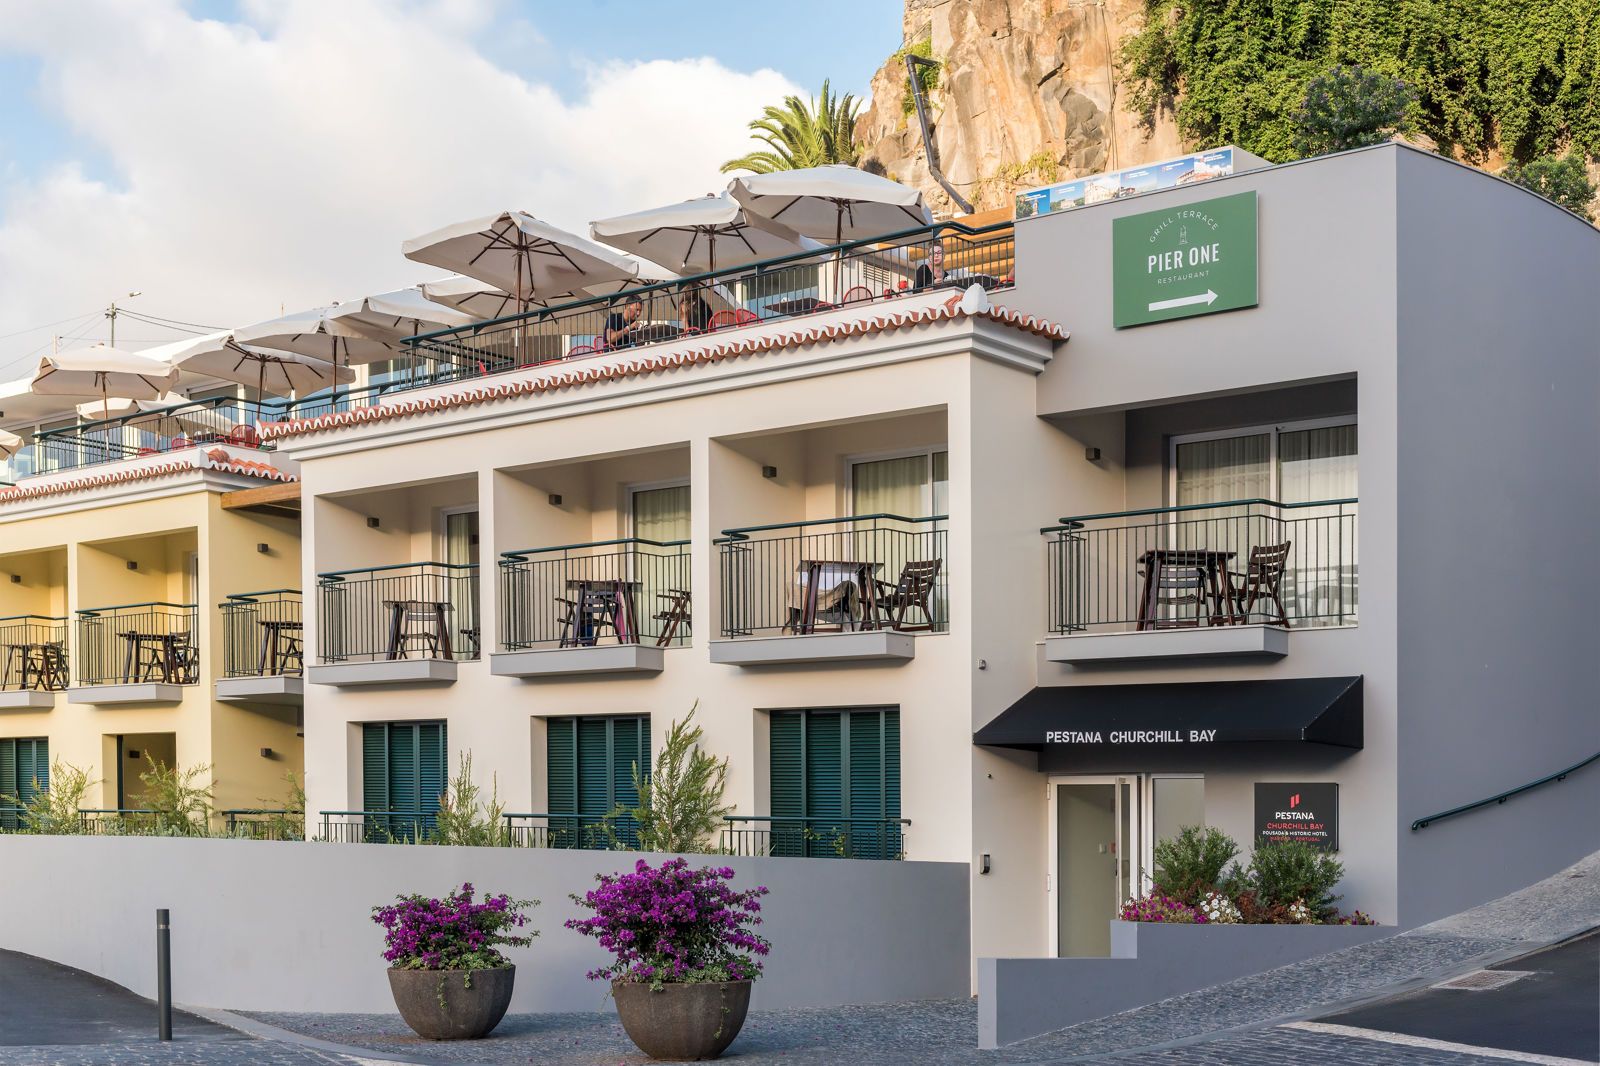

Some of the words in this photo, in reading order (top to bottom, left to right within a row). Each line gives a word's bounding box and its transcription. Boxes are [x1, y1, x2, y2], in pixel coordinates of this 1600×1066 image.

[1149, 217, 1174, 243] GRILL
[1177, 210, 1219, 231] TERRACE
[1148, 250, 1183, 274] PIER
[1189, 243, 1220, 266] ONE
[1157, 270, 1210, 285] RESTAURANT
[1046, 731, 1103, 744] PESTANA
[1109, 730, 1183, 744] CHURCHILL
[1189, 729, 1217, 742] BAY
[1275, 811, 1315, 820] PESTANA
[1266, 822, 1309, 830] CHURCHILL
